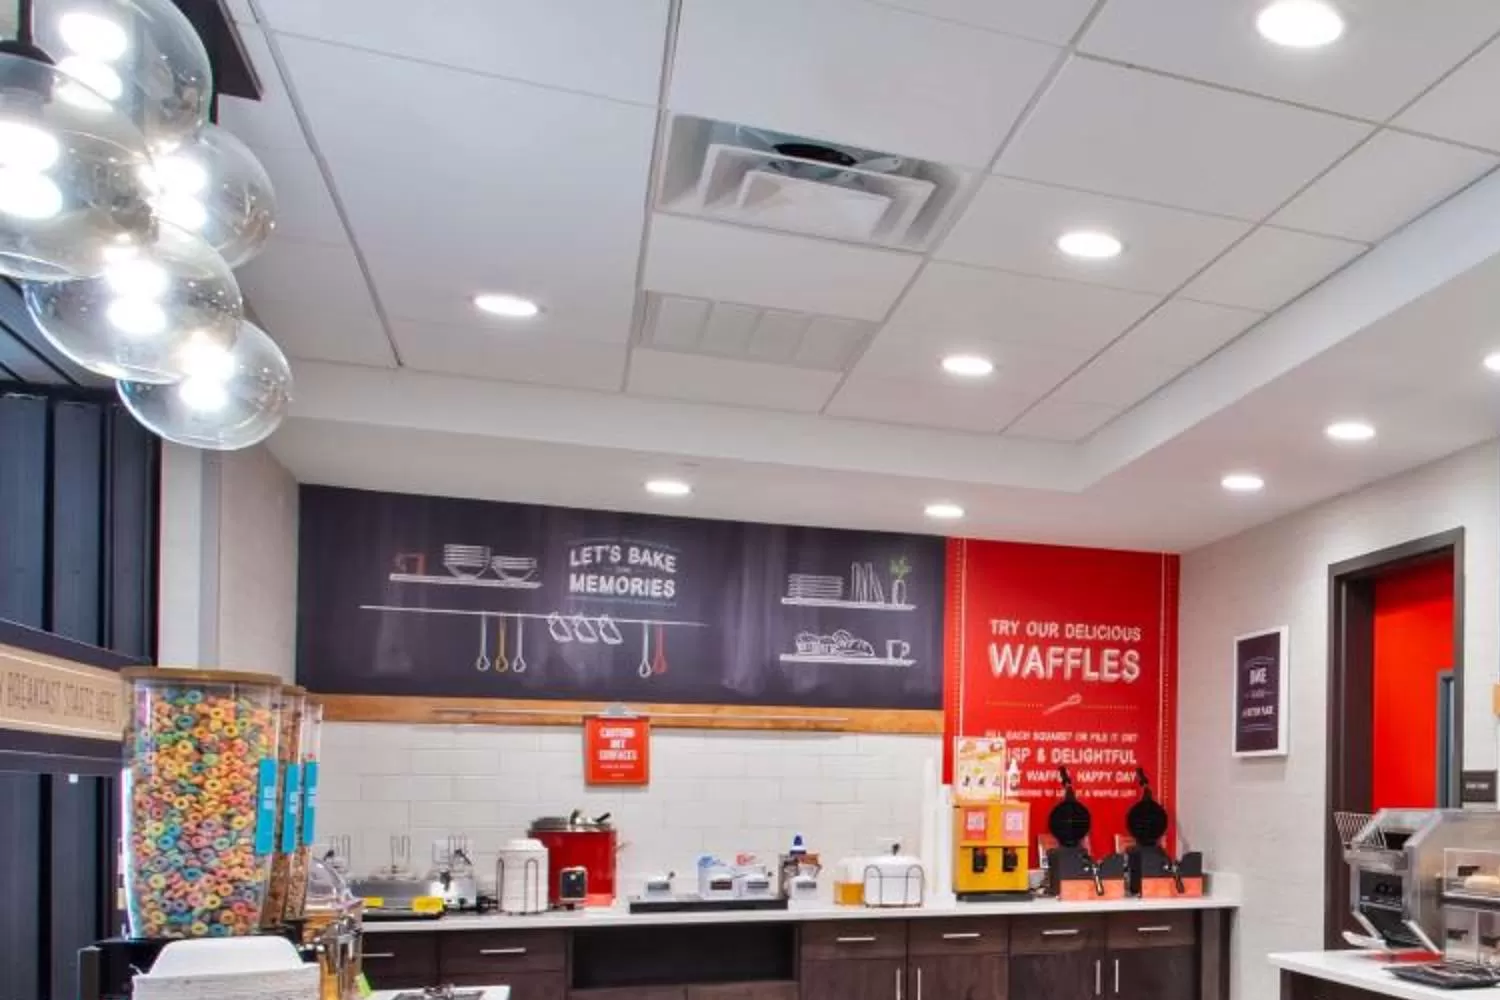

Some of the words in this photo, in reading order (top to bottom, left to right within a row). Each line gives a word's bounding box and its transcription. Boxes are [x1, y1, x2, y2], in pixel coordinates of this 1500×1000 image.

[569, 545, 621, 567] LET'S
[628, 547, 677, 573] BAKE
[569, 573, 675, 598] MEMORIES
[990, 619, 1020, 636] TRY
[1025, 621, 1059, 638] OUR
[1065, 623, 1141, 641] DELICIOUS
[988, 642, 1141, 683] WAFFLES
[1051, 748, 1137, 765] DELIGHTFUL
[1076, 771, 1112, 783] HAPPY
[1115, 772, 1137, 783] DAY
